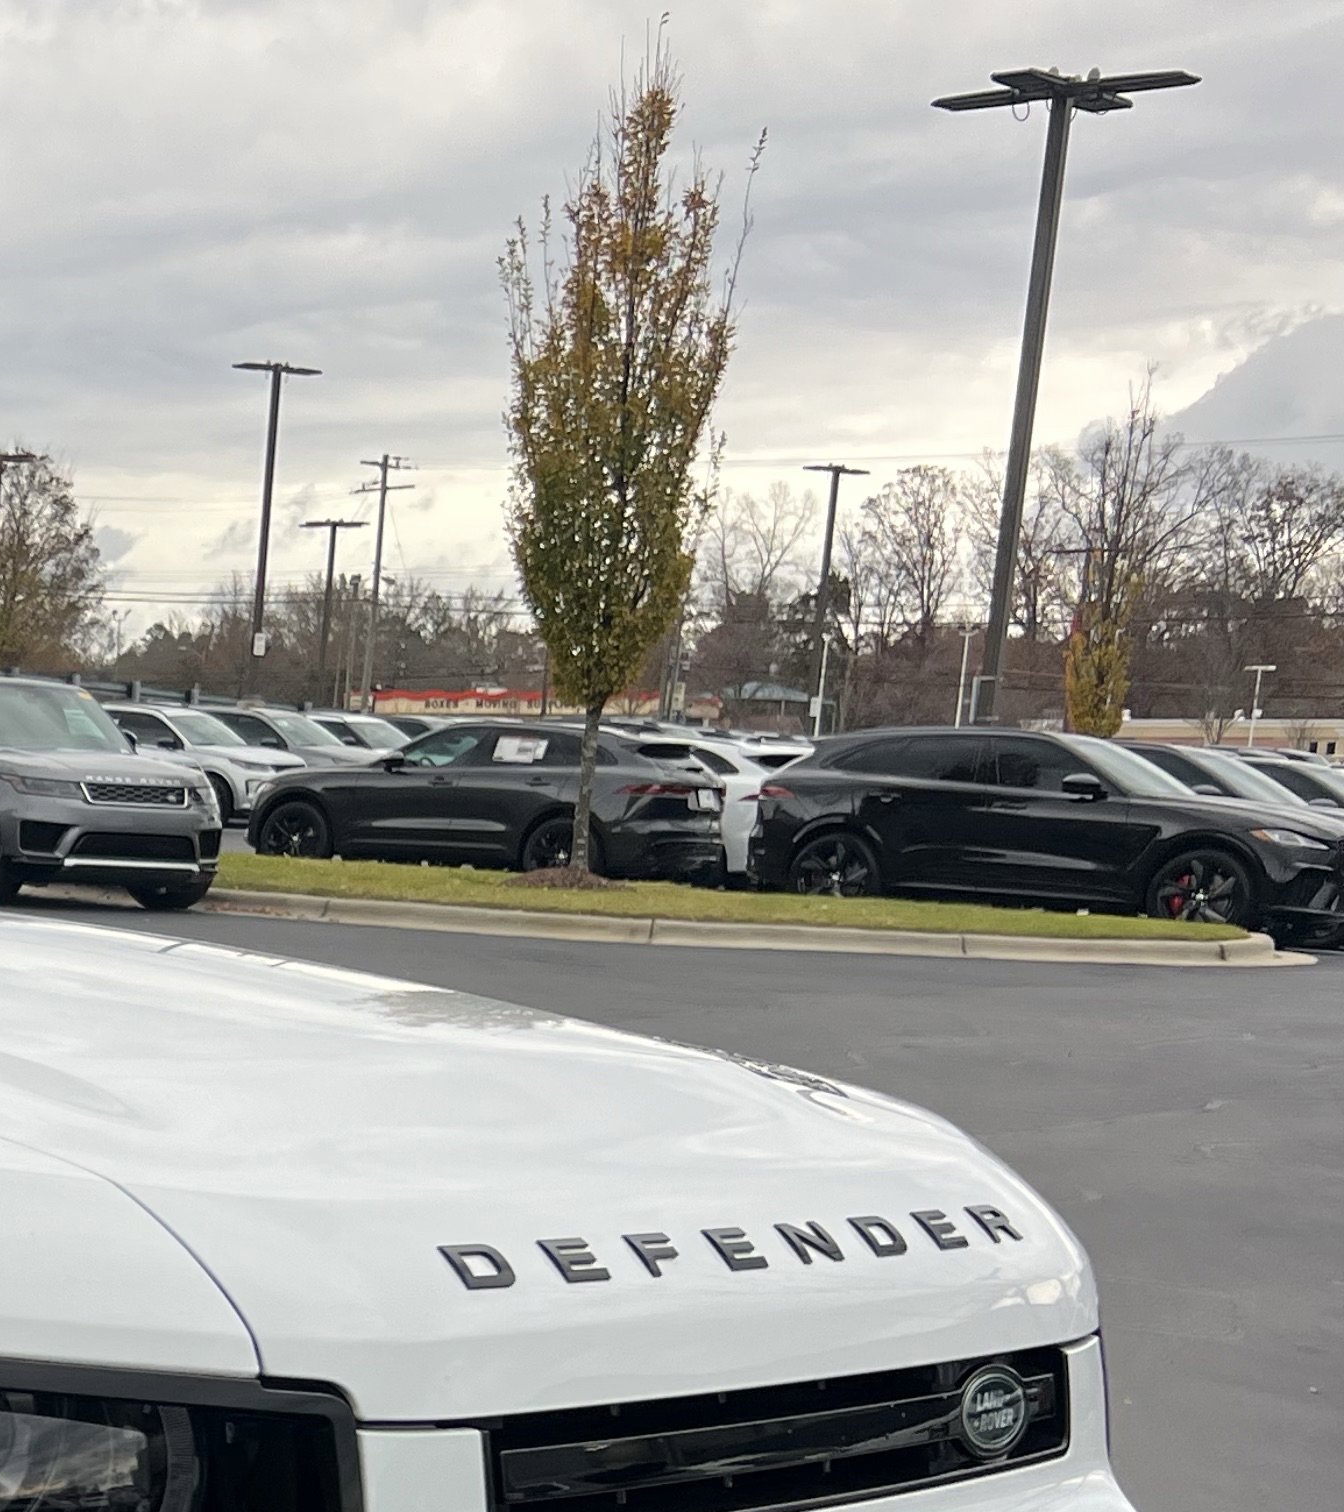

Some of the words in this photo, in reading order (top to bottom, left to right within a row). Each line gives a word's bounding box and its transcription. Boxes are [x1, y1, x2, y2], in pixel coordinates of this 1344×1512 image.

[85, 775, 132, 784] RANGE
[139, 777, 181, 786] ROVER
[435, 1204, 1024, 1291] DEFENDER
[975, 1388, 1005, 1413] LAND
[979, 1407, 1014, 1432] ROVER
